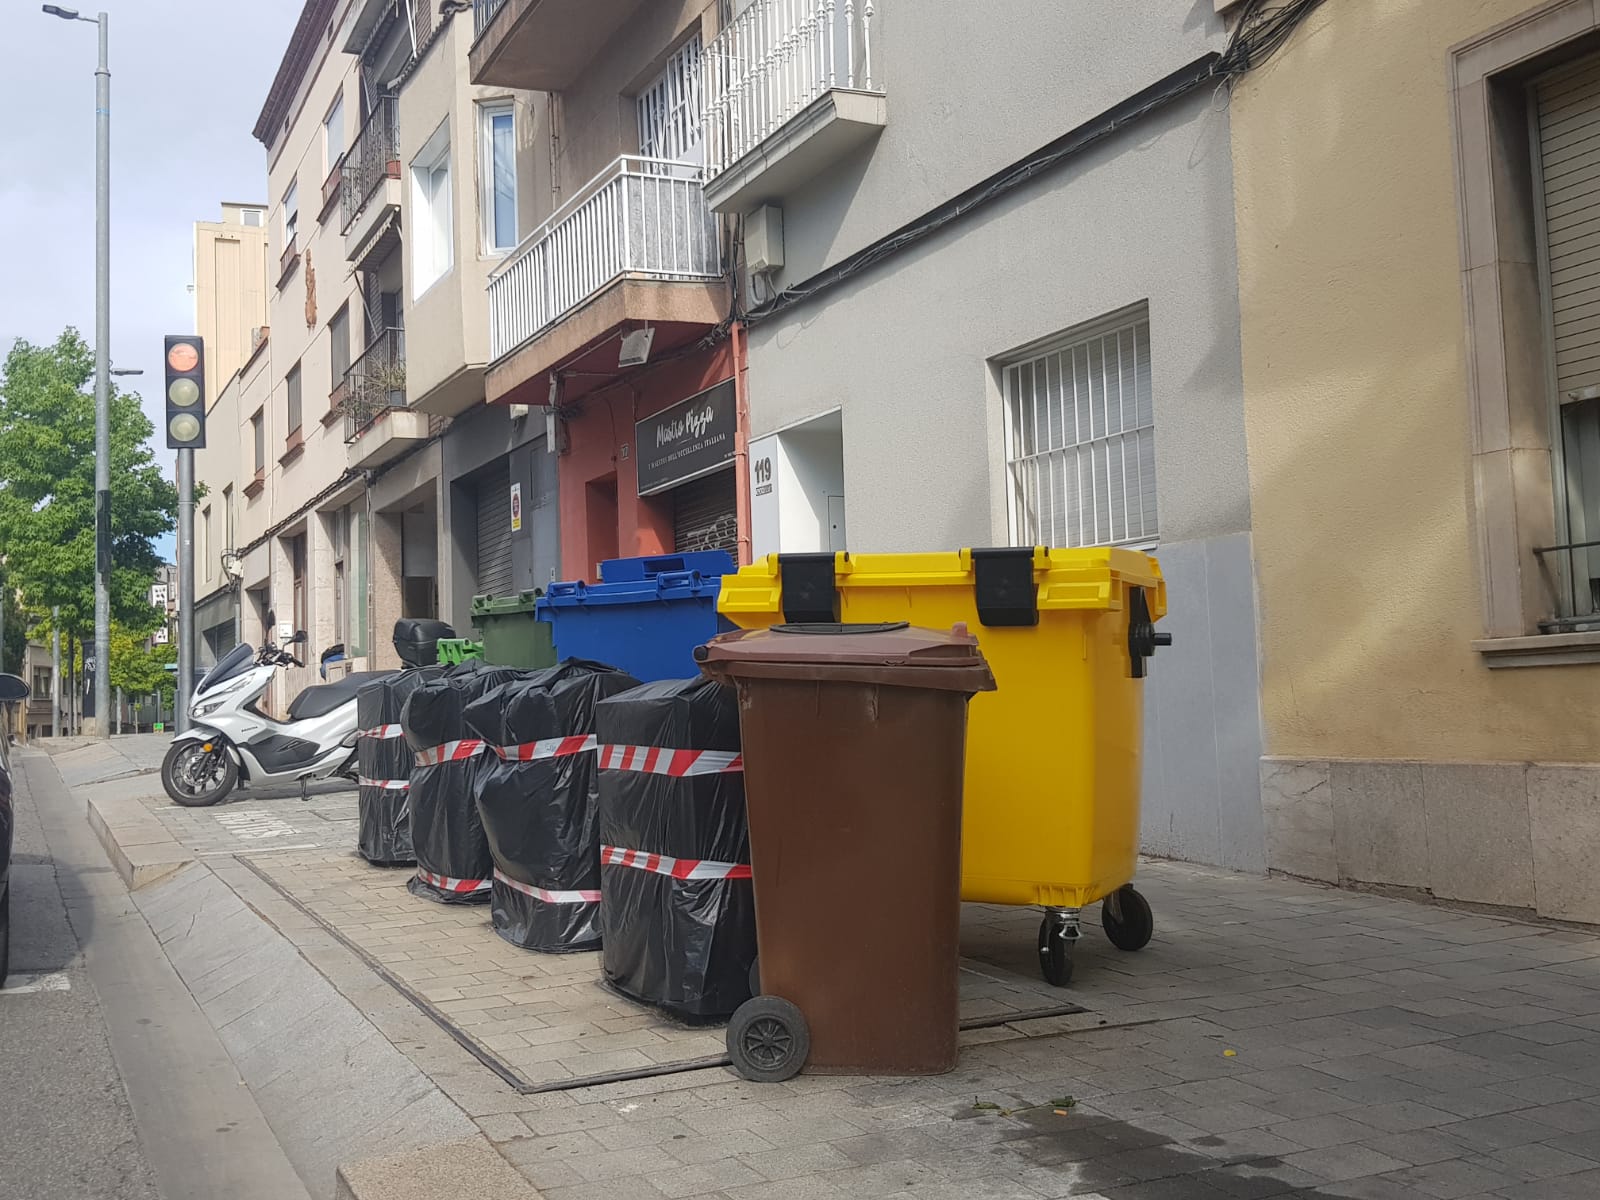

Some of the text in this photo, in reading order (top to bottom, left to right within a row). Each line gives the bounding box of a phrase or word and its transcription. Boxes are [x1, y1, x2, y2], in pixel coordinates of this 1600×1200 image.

[656, 406, 713, 448] Mastro Pizza
[754, 457, 771, 484] 119
